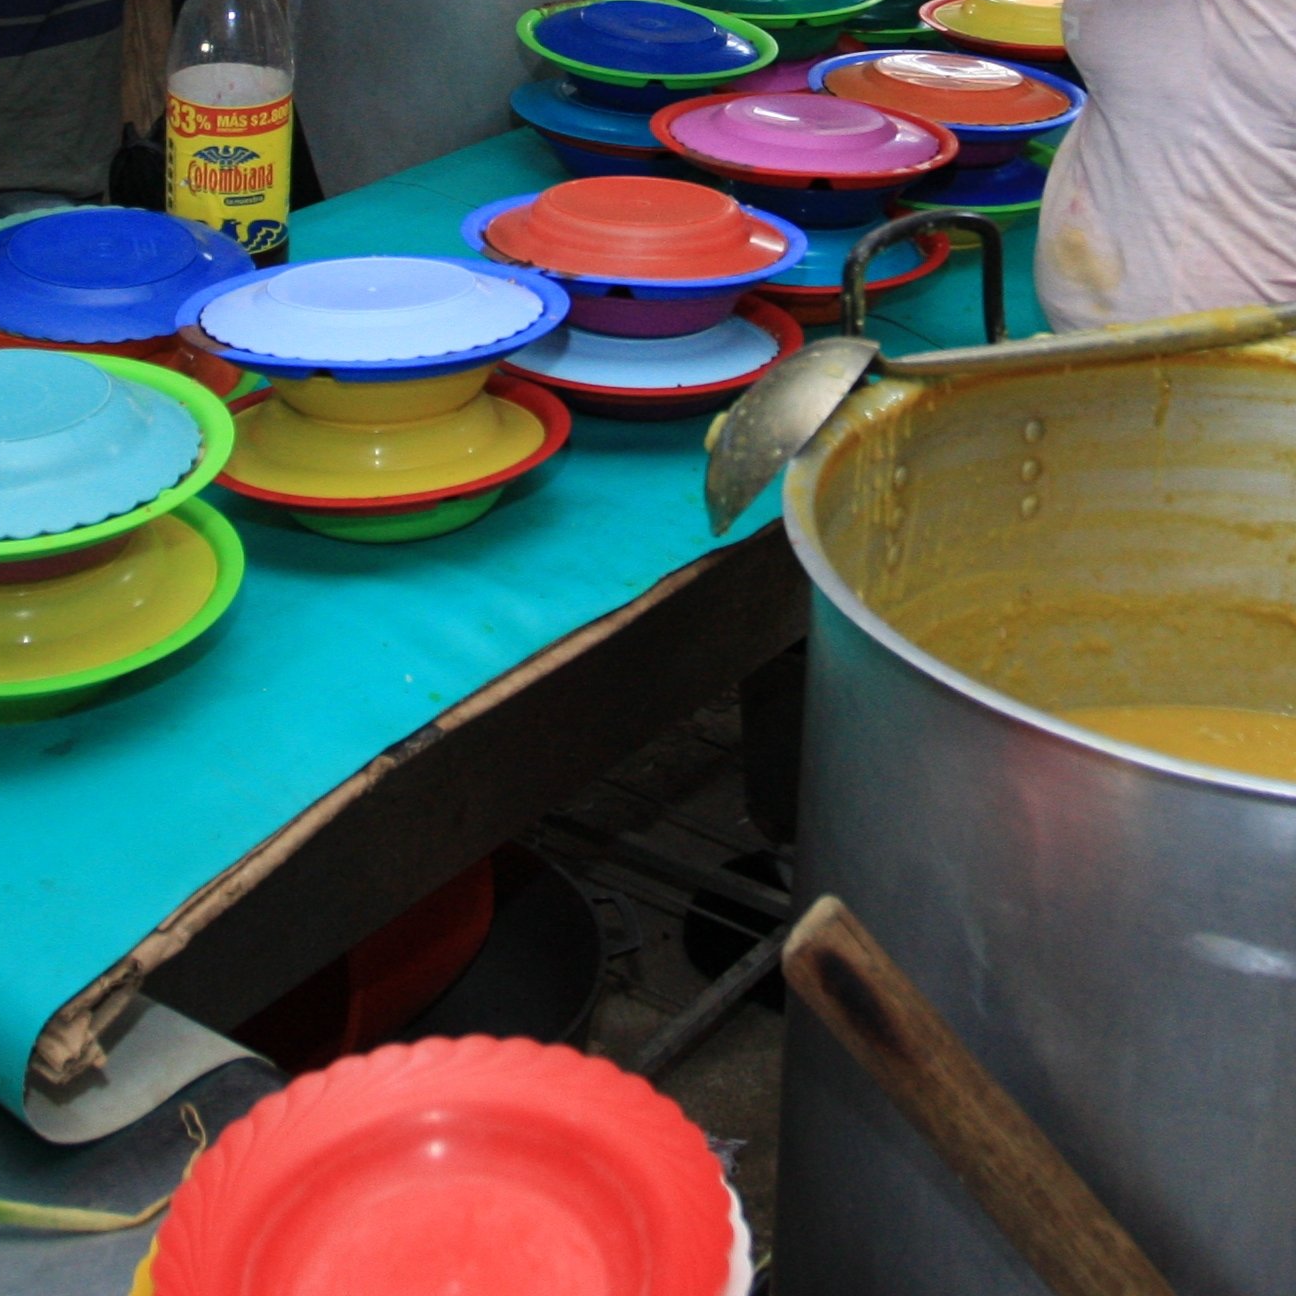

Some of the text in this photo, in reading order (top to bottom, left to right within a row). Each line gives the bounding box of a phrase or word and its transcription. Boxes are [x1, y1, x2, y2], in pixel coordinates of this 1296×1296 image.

[168, 98, 212, 134] 33%
[216, 112, 248, 128] MÁS
[188, 160, 274, 195] Colombiana
